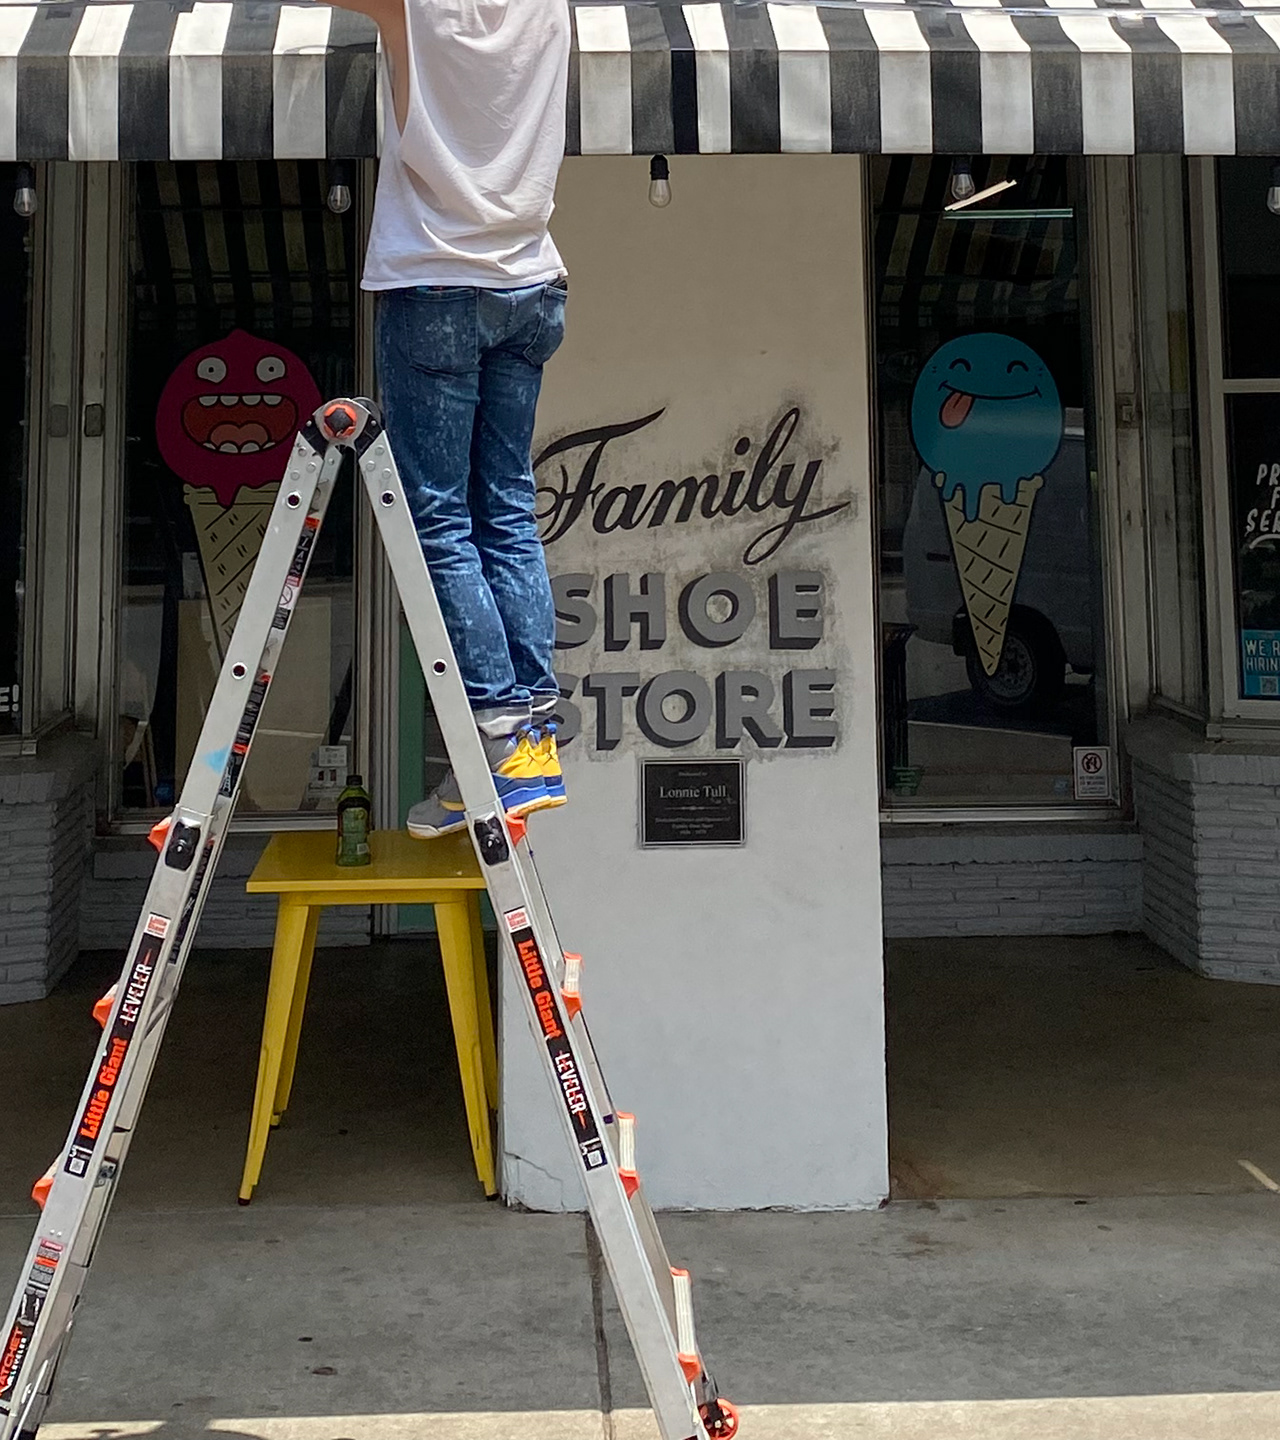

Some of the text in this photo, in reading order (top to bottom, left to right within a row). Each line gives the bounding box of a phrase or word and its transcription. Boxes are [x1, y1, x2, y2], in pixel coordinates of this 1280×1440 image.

[532, 406, 852, 565] Family
[550, 570, 824, 652] SHOE
[660, 785, 727, 799] Lonnie Tull
[79, 1089, 110, 1140] Little
[98, 1037, 128, 1087] Giant
[120, 963, 153, 1023] LEVELER
[518, 938, 543, 989] Little
[534, 990, 562, 1039] Giant
[554, 1052, 587, 1115] LEVELER
